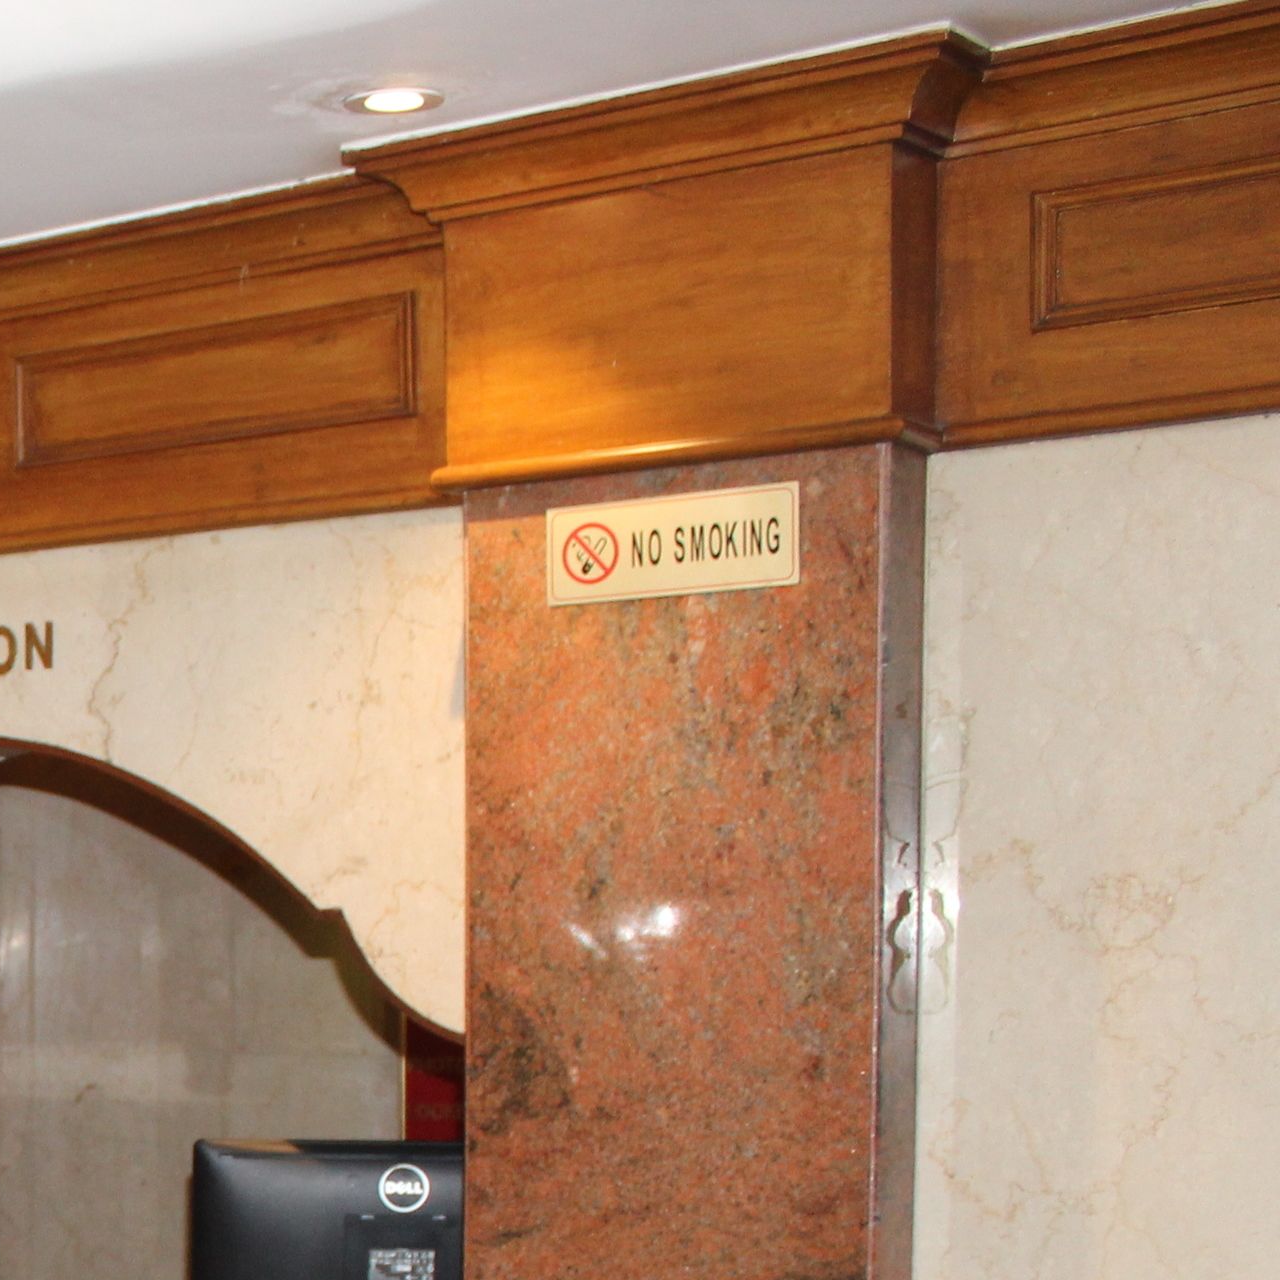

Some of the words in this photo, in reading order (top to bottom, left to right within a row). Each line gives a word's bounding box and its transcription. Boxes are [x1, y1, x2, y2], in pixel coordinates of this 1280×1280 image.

[631, 529, 662, 568] NO
[674, 517, 781, 563] SMOKING
[385, 1181, 423, 1195] DELL
